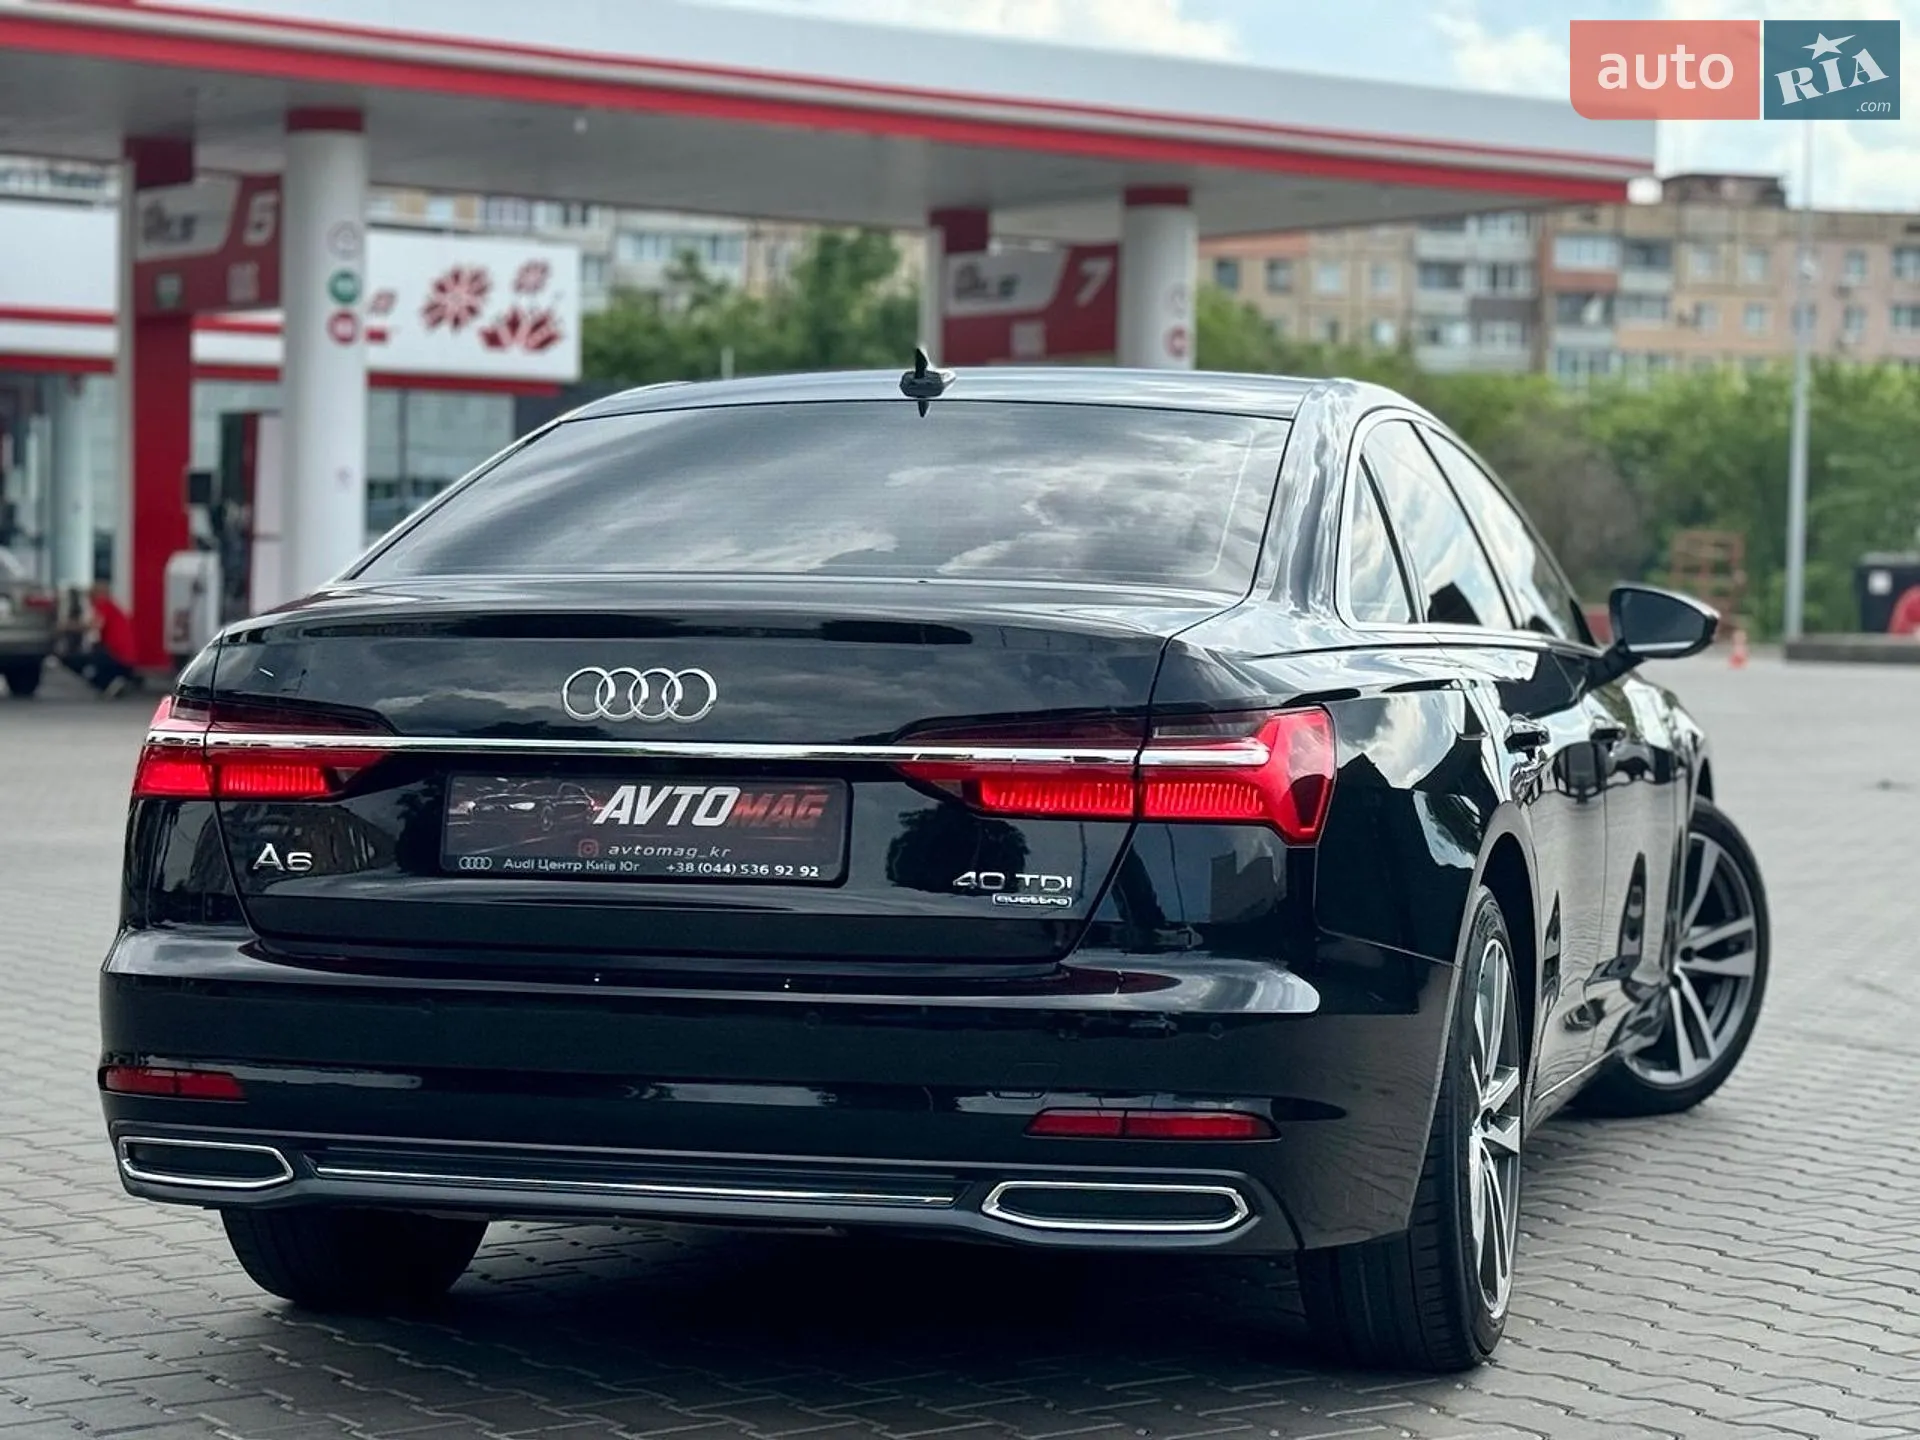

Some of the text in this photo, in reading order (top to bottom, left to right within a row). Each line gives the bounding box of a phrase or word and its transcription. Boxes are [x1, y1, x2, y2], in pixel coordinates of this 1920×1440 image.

[244, 191, 278, 245] 5
[1077, 259, 1113, 306] 7
[252, 842, 313, 872] A6
[608, 844, 731, 859] avtomag_kr
[503, 858, 535, 870] Audi
[538, 858, 583, 871] Центр
[620, 861, 640, 871] Юг
[666, 862, 819, 877] +38 (044) 536 92 92
[953, 871, 1073, 891] 40 TDI
[996, 894, 1068, 905] quattro
